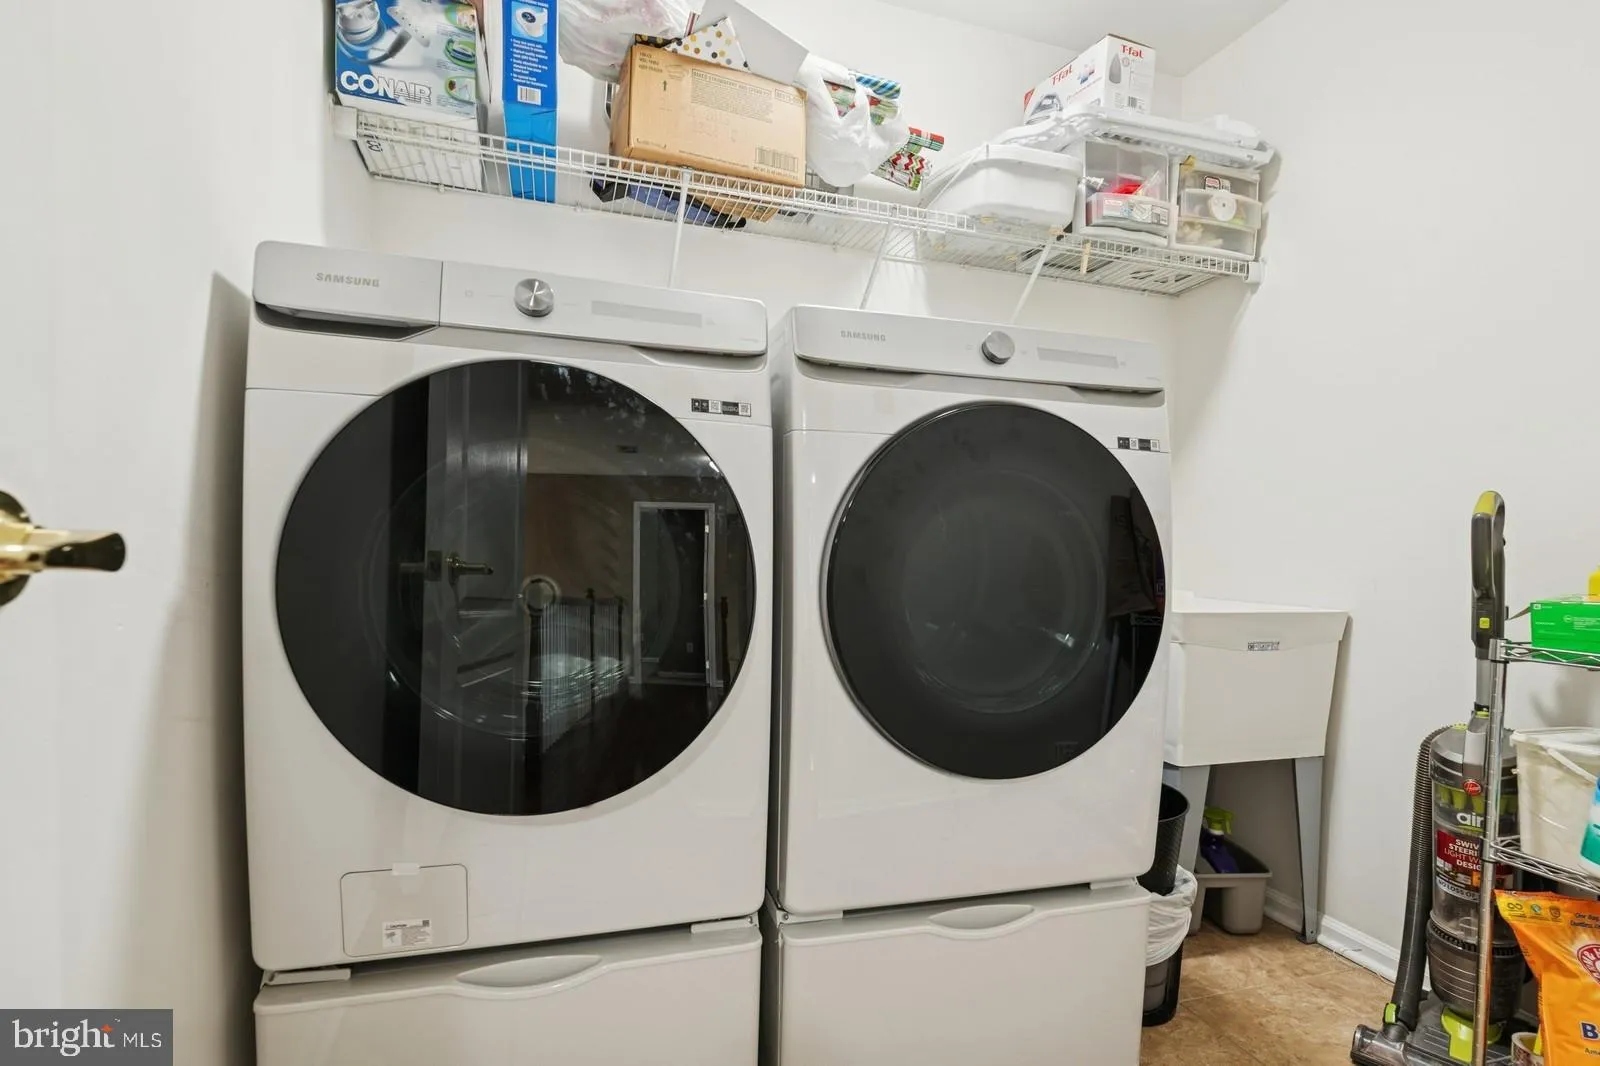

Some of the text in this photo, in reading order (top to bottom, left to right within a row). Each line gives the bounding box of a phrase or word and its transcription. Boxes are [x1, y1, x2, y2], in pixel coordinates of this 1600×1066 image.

[1121, 45, 1144, 59] T-fal
[1051, 64, 1073, 86] T-fal
[340, 71, 432, 104] CONAIR
[316, 272, 380, 288] SAMSUNG
[840, 330, 886, 342] SAMSUNG
[1456, 812, 1484, 828] air
[1444, 847, 1467, 860] LIGHT
